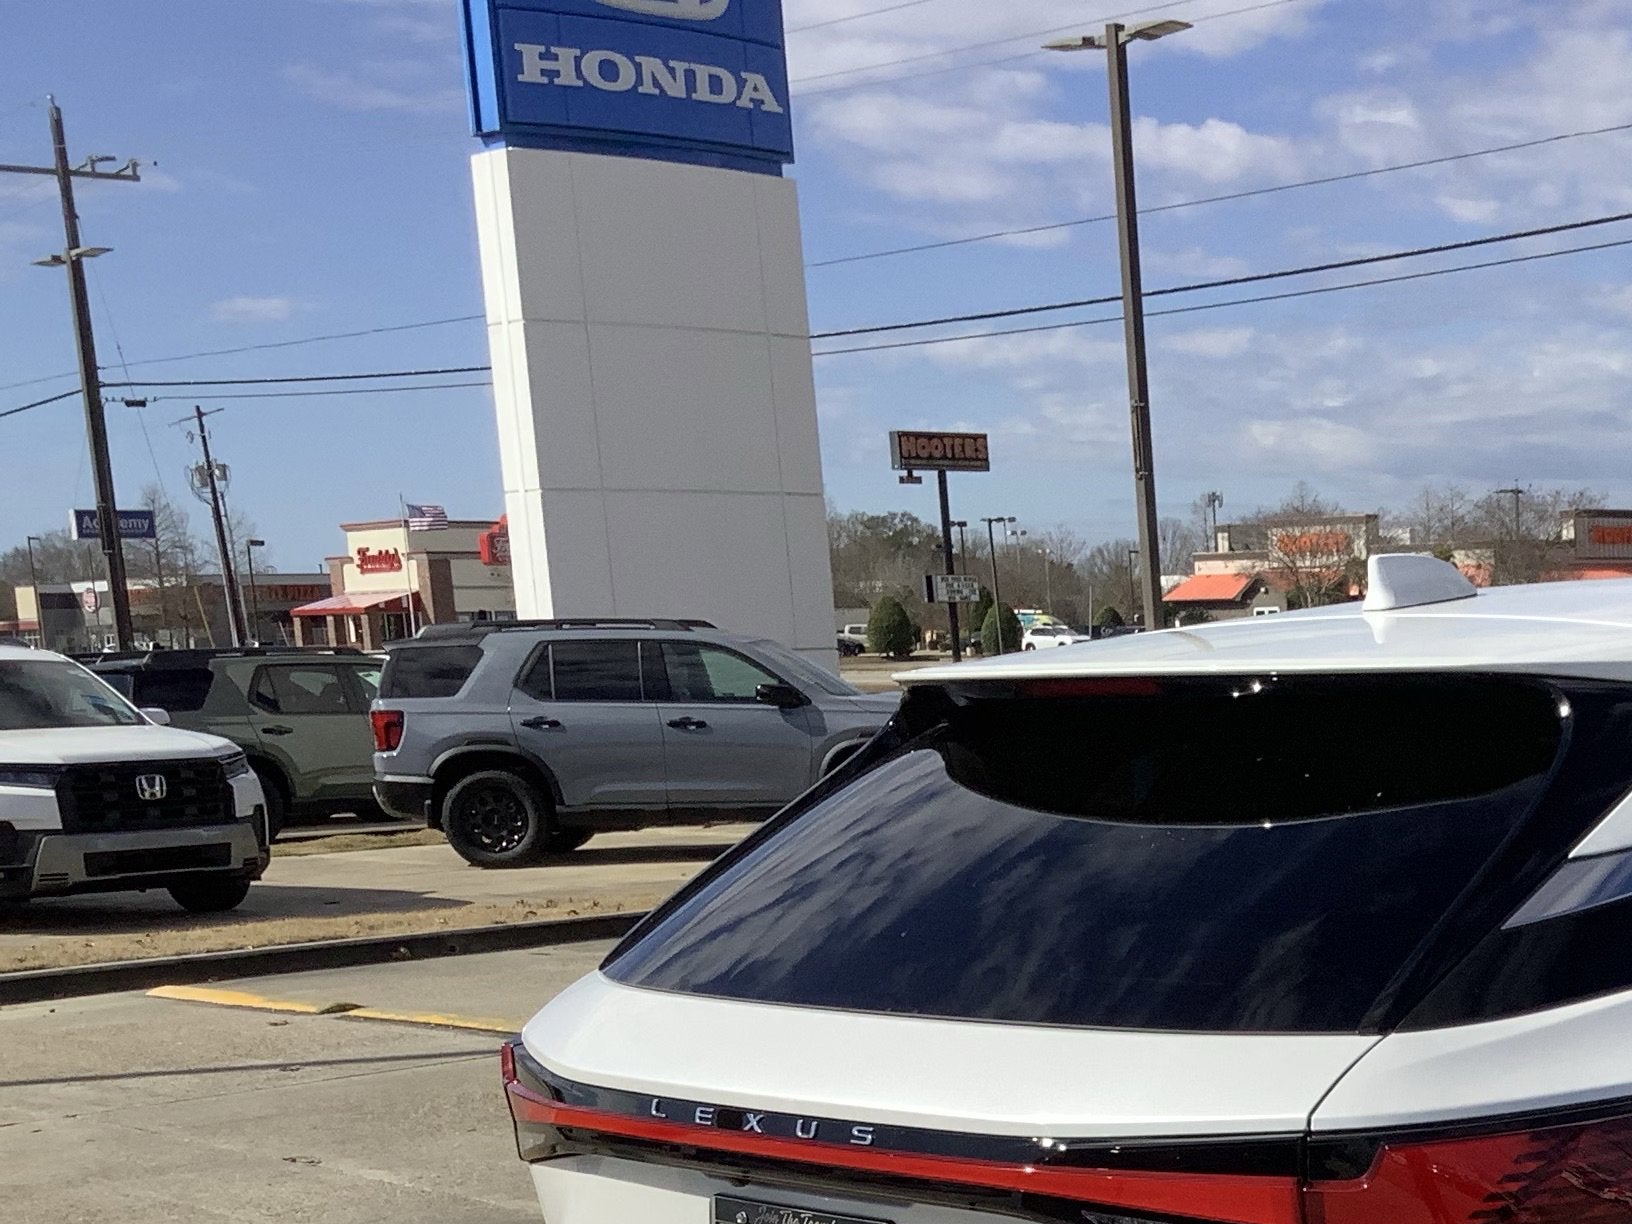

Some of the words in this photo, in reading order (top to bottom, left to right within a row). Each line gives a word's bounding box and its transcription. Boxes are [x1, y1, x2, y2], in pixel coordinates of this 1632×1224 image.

[514, 43, 783, 114] HONDA
[900, 435, 988, 459] HOOTERS
[650, 1098, 875, 1146] LEXUS
